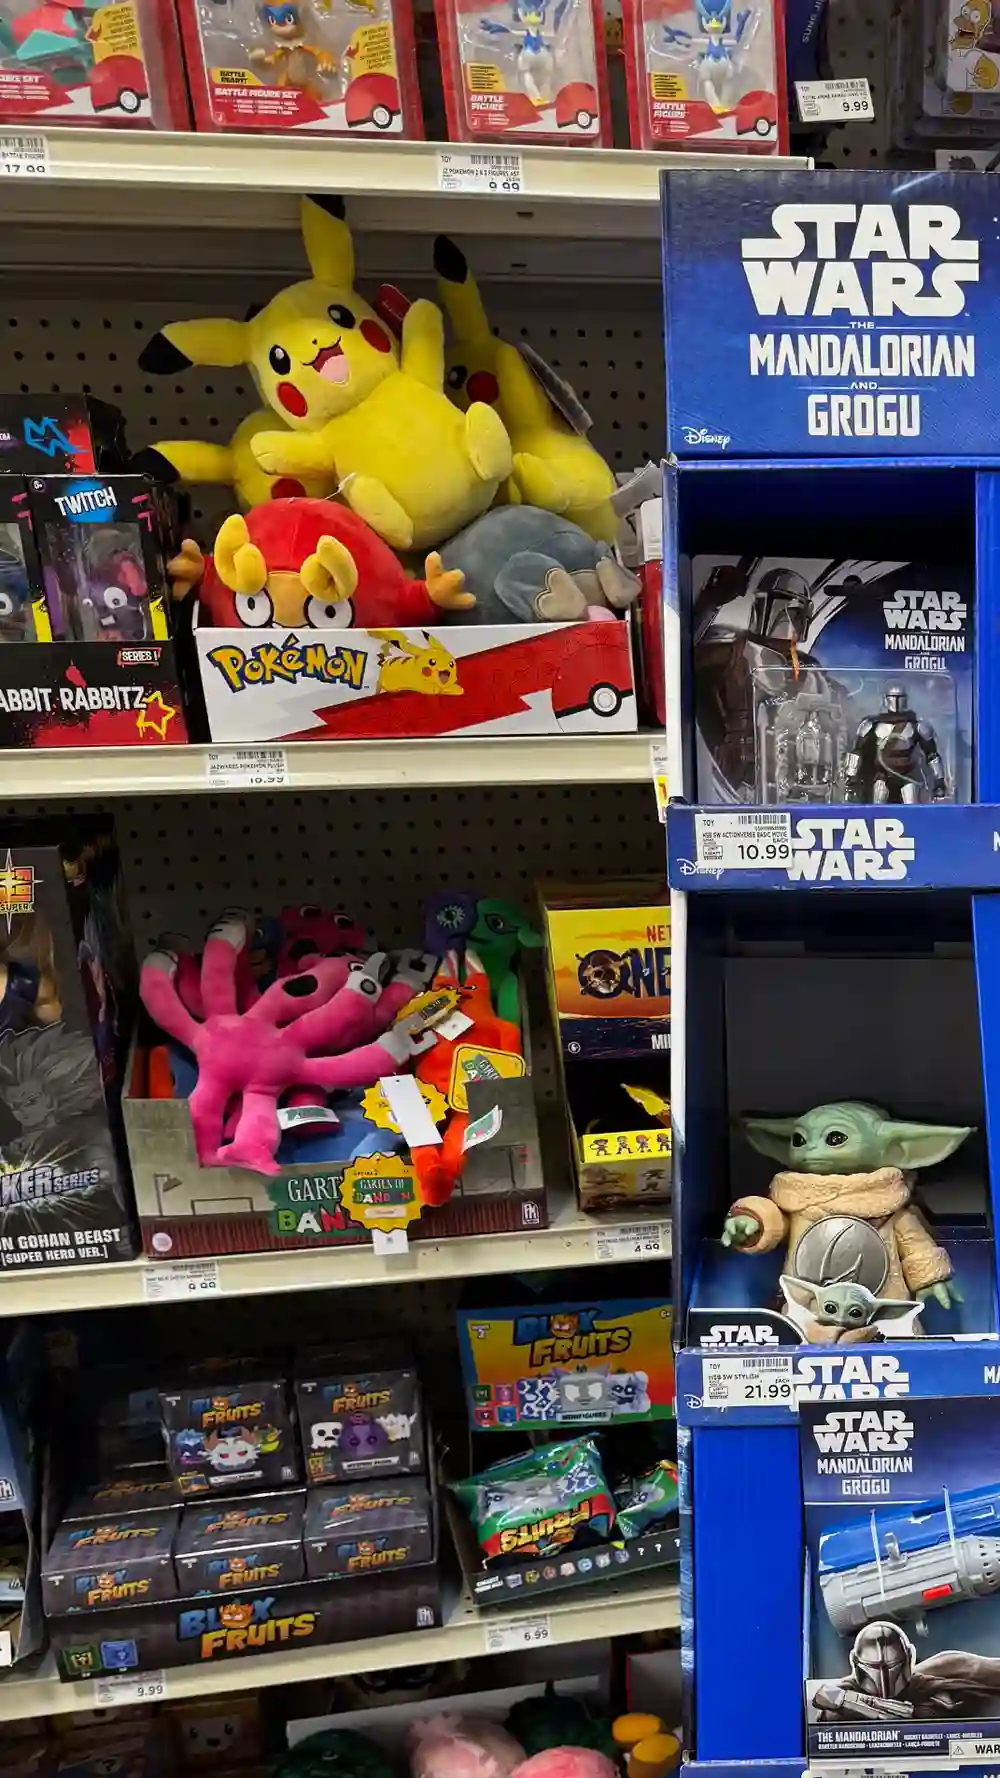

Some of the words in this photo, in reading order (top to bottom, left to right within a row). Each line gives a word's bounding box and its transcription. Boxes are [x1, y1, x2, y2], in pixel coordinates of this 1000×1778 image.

[214, 87, 248, 98] BATTLE
[279, 89, 301, 100] SET
[842, 101, 870, 113] 9.99
[741, 204, 980, 261] STAR
[742, 262, 981, 318] WARS
[748, 334, 976, 378] MANDALORIAN
[806, 394, 921, 438] GROGU
[54, 486, 118, 518] TWITCH
[883, 589, 967, 611] STAR
[883, 608, 967, 632] WARS
[884, 634, 966, 652] MANDALORIAN
[904, 655, 947, 670] GROGU
[59, 685, 147, 712] RABBITZ
[793, 818, 915, 850] STAR
[737, 844, 790, 860] 10.99
[787, 850, 916, 881] WARS
[18, 1230, 71, 1250] GOHAN
[74, 1228, 121, 1245] BEAST
[45, 1248, 74, 1262] HERO
[529, 1326, 632, 1368] FRUITS
[744, 1384, 791, 1399] 21.99
[812, 1410, 915, 1433] STAR
[812, 1430, 915, 1453] WARS
[817, 1456, 913, 1474] MANDALORIAN
[841, 1478, 891, 1495] GROGU
[201, 1612, 317, 1659] FRUITS
[523, 1629, 550, 1642] 6.99
[135, 1684, 164, 1698] 9.99
[817, 1731, 832, 1742] THE
[833, 1730, 900, 1742] MANDALORIAN
